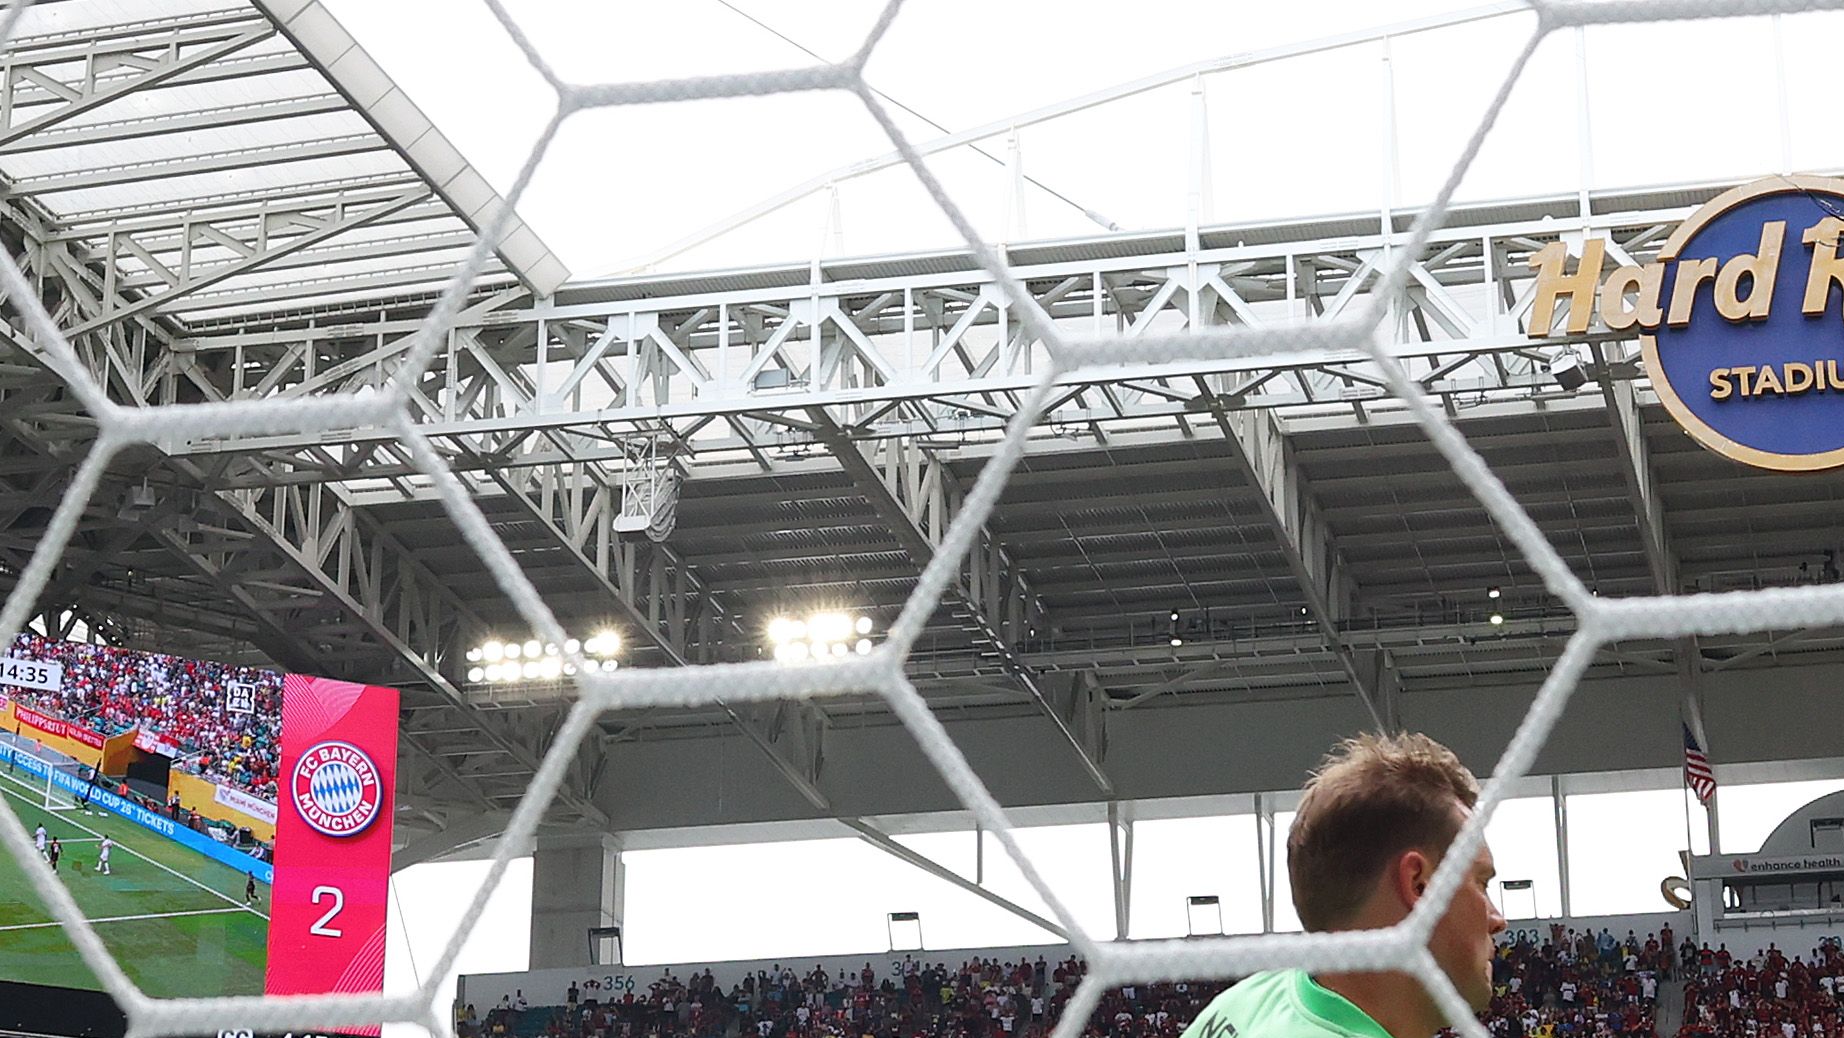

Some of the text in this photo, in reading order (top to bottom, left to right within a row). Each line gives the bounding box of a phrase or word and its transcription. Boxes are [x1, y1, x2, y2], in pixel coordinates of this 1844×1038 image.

[1528, 219, 1786, 338] Hard
[299, 747, 374, 786] FC BAYERN
[137, 806, 175, 835] TICKETS
[1751, 857, 1841, 872] enhance health
[309, 885, 345, 938] 2
[602, 975, 635, 991] 356
